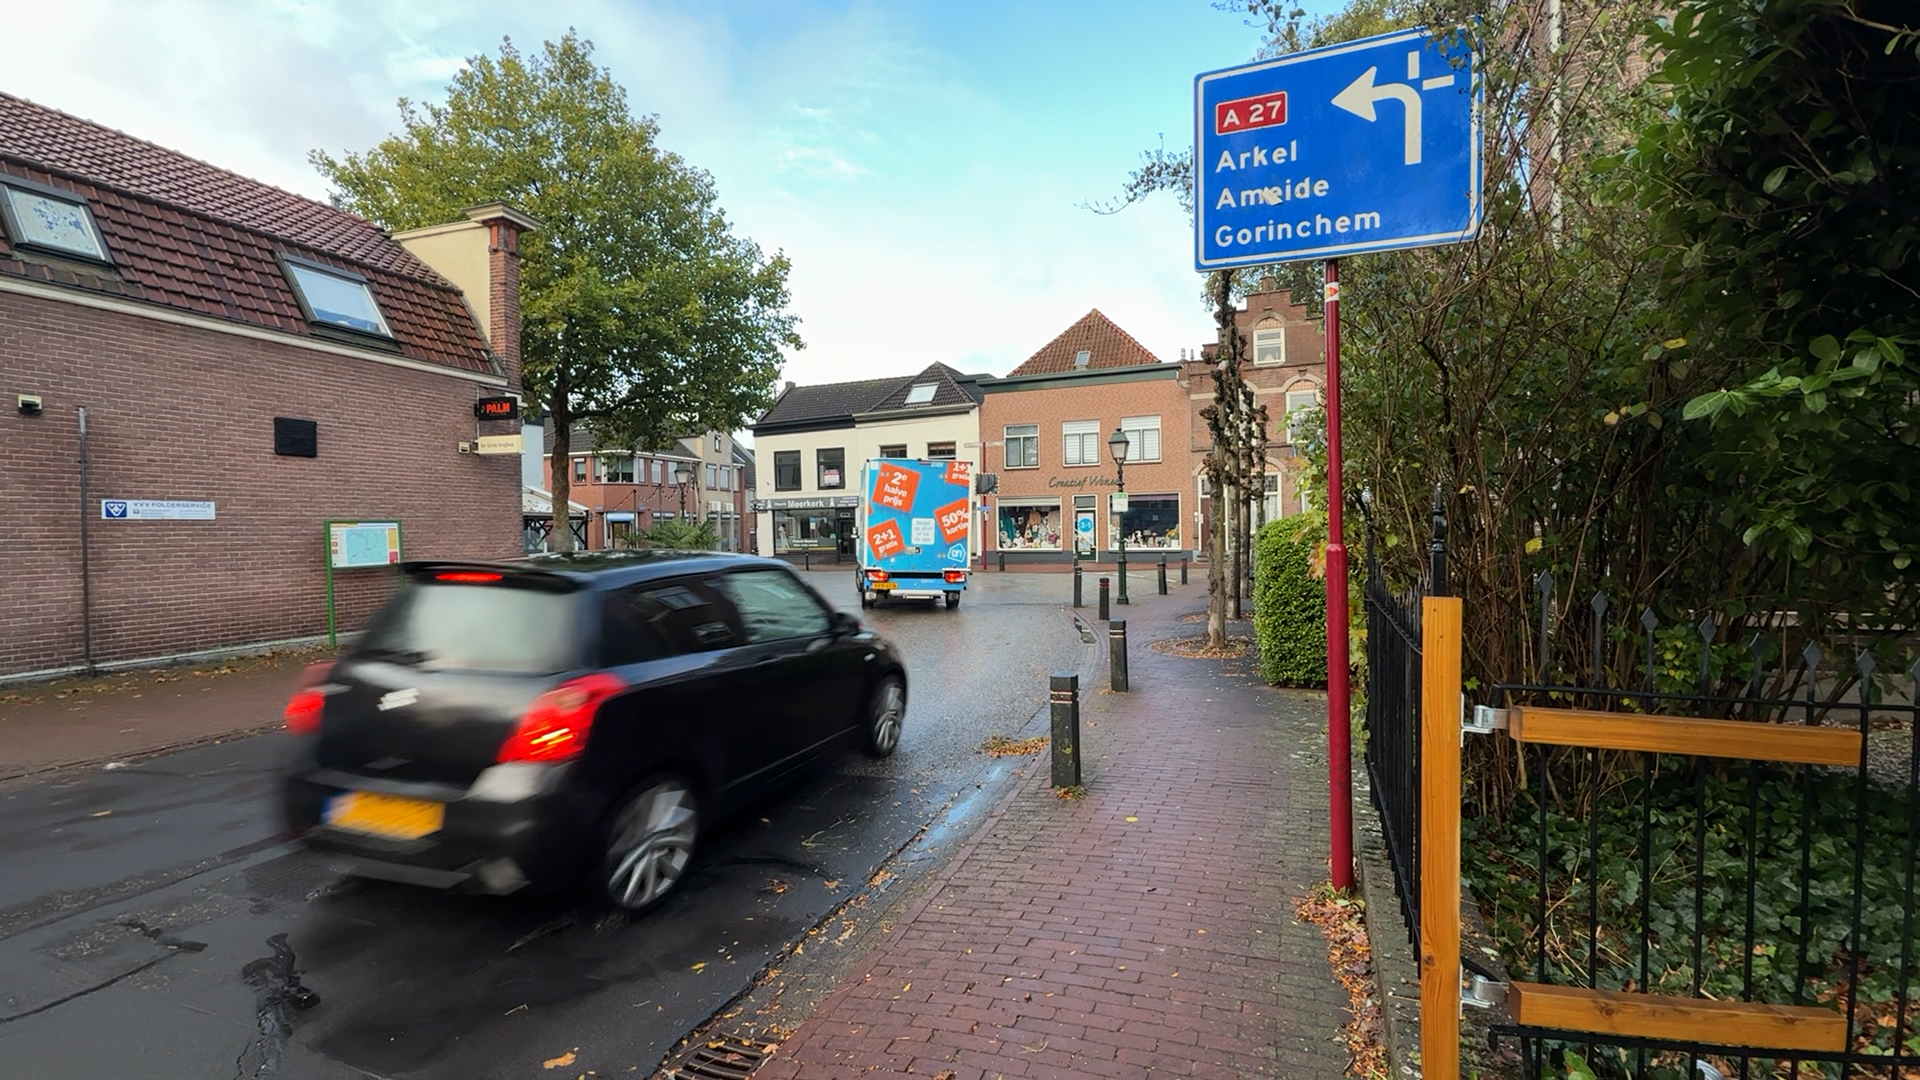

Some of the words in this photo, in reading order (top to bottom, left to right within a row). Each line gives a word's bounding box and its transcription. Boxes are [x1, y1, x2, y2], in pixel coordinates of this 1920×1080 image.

[1223, 109, 1240, 128] A
[1249, 100, 1282, 123] 27
[1215, 139, 1297, 173] Arkel
[1215, 177, 1330, 210] Ameide
[1215, 211, 1381, 247] Gorinchem
[486, 402, 510, 413] PALM
[884, 484, 908, 498] halve
[1049, 476, 1087, 492] Creatief
[787, 499, 825, 508] Meerkerk
[883, 495, 904, 507] prijs
[941, 507, 970, 527] 50%
[873, 528, 896, 545] 2+1
[878, 540, 899, 554] gratis
